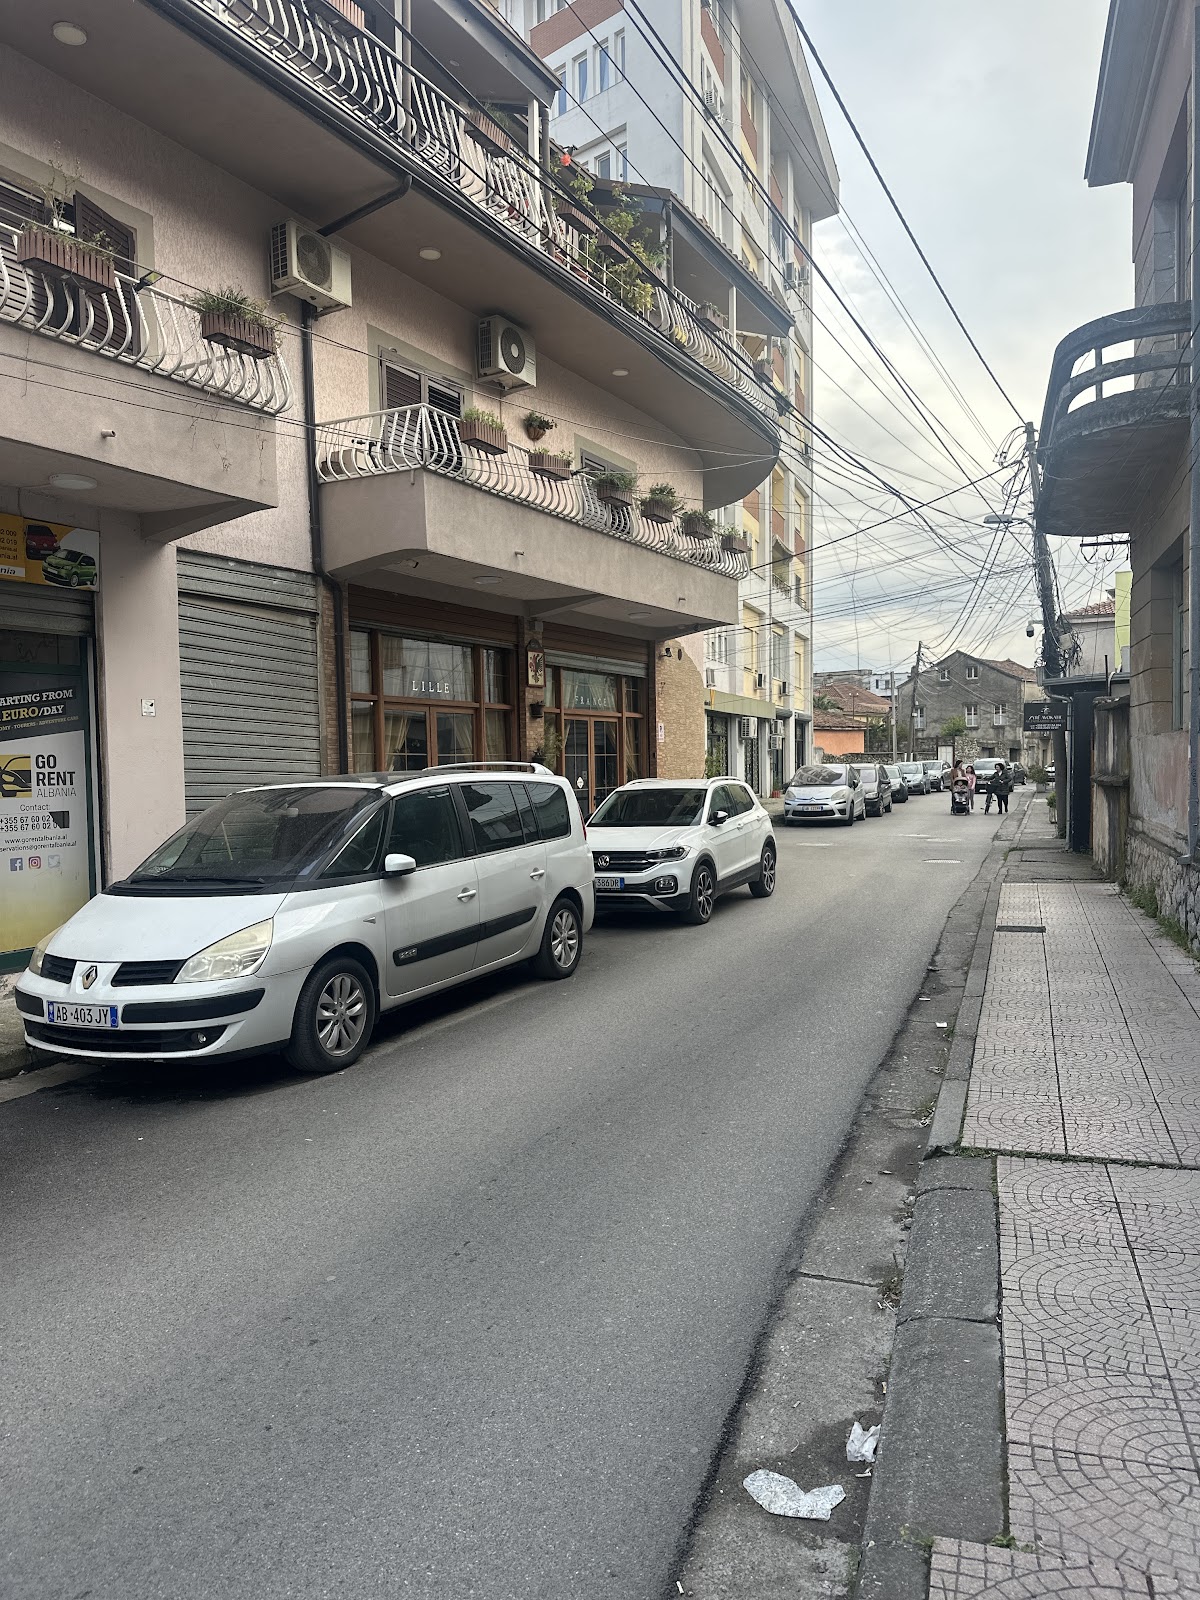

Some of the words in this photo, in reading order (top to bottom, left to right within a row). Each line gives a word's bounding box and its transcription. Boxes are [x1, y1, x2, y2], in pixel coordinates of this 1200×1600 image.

[412, 680, 450, 694] LILLE
[42, 689, 73, 701] FROM
[575, 695, 607, 707] FRANCE
[2, 705, 65, 721] EURO/DAY
[35, 754, 57, 769] GO
[36, 771, 75, 787] RENT
[36, 788, 77, 798] ALBANIA
[20, 804, 50, 812] Contact:
[56, 1006, 68, 1021] AB
[73, 1008, 93, 1024] 403
[95, 1009, 109, 1024] JY
